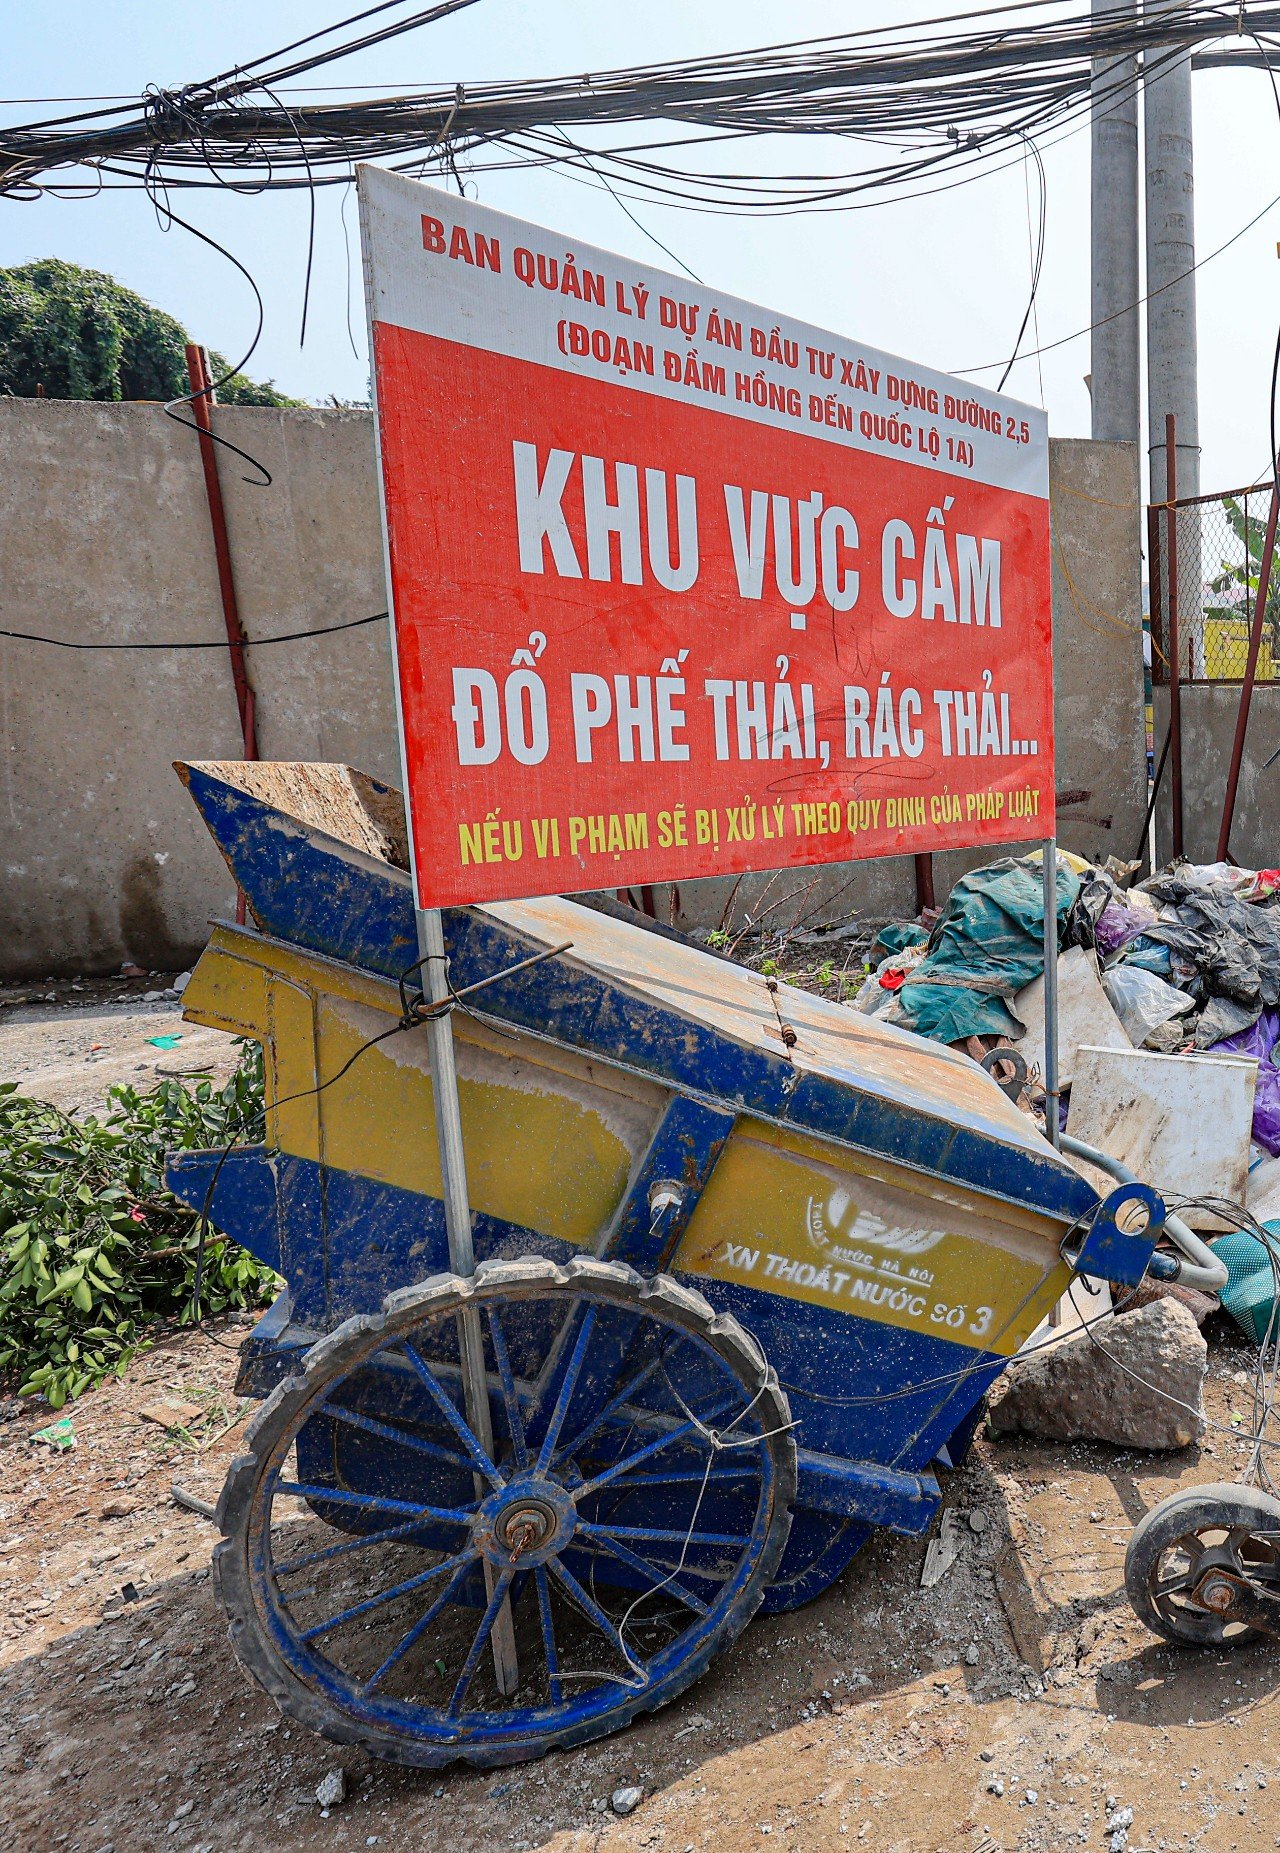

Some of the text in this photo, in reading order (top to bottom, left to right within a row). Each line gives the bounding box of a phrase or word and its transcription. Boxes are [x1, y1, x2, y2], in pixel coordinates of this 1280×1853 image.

[421, 213, 1031, 447] BAN QUẢN LÝ DỰ ÁN ĐẦU TƯ XÂY DỰNG ĐƯỜNG 2,5
[557, 319, 974, 469] (ĐOẠN ĐẦM HỒNG ĐẾN QUỐC LỘ 1A)
[511, 440, 1003, 631] KHU VỰC CẤM
[451, 630, 1039, 771] ĐỔ PHẾ THẢI, RÁC THẢI...
[458, 784, 1040, 866] NẾU VI PHẠM SẼ BỊ XỬ LÝ THEO QUY ĐỊNH CỦA PHÁP LUẬT
[719, 1242, 994, 1336] XN THOÁT NƯỚC SỐ 3
